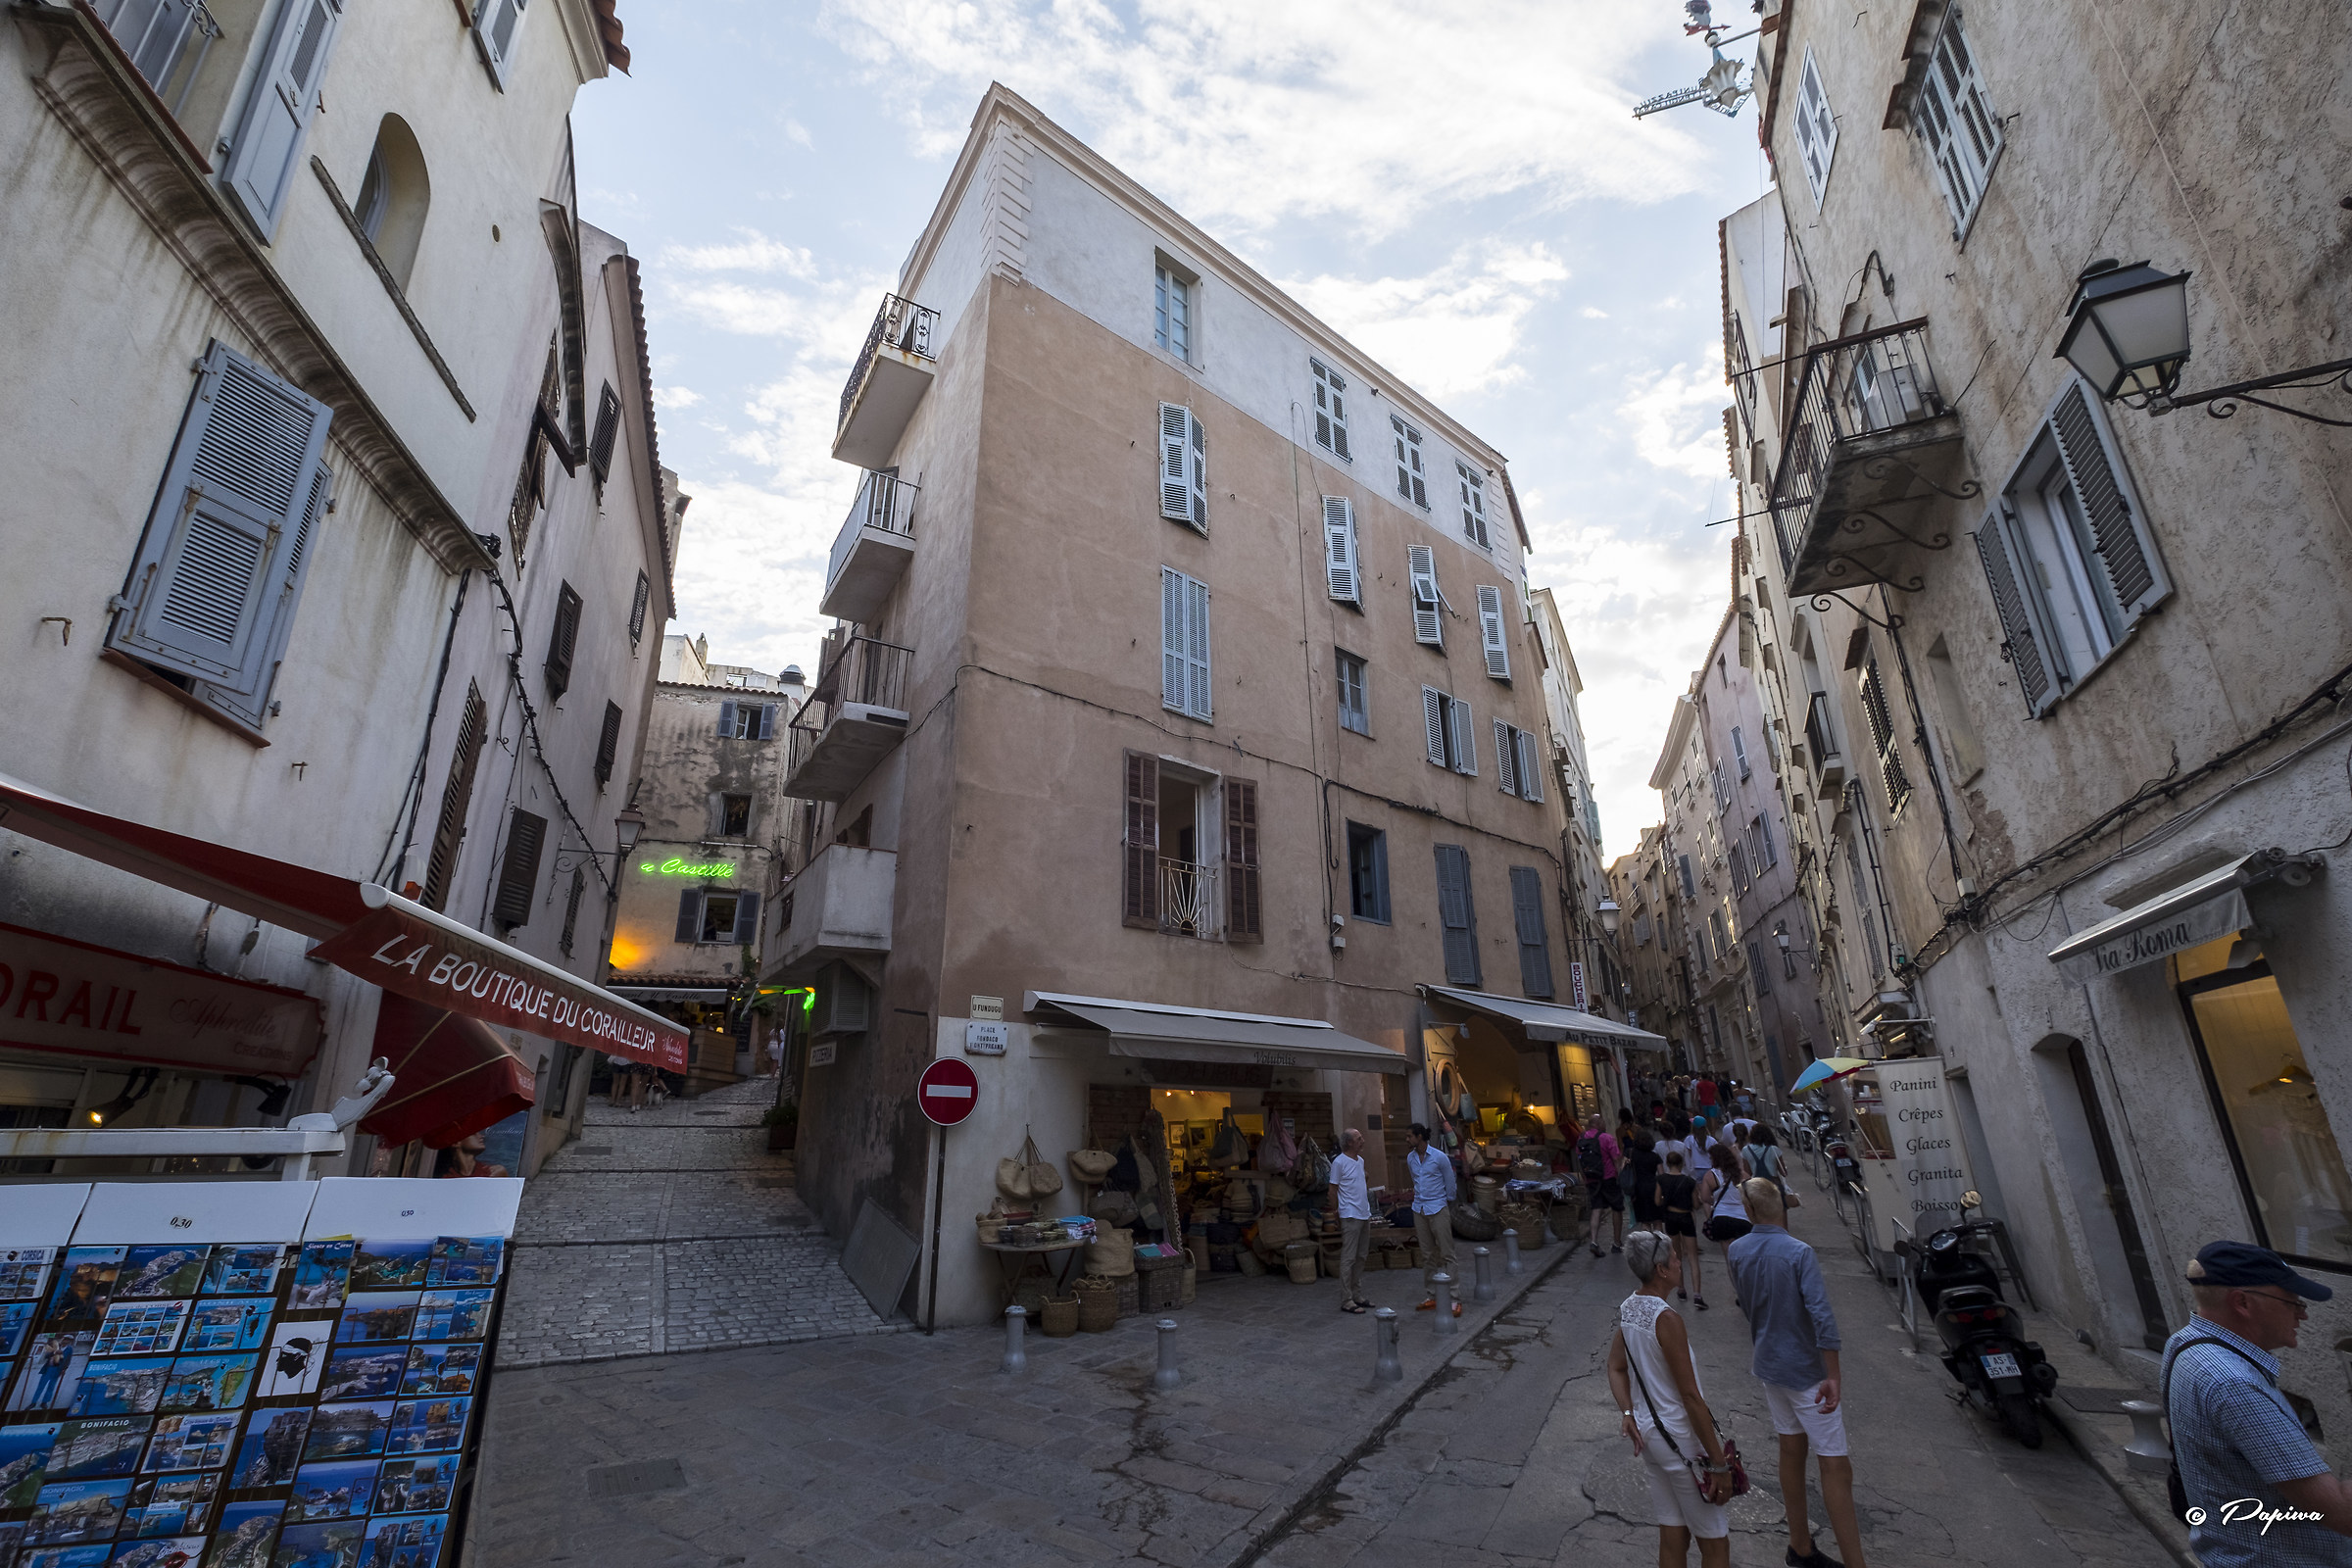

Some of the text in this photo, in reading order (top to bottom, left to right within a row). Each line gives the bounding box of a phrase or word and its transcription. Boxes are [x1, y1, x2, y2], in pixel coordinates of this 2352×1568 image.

[661, 858, 736, 878] Castillé
[2090, 921, 2192, 974] Via Roma
[370, 933, 657, 1053] LA BOUTIQUE DU CORAILLEUR
[169, 994, 276, 1039] Aphrodite
[1253, 1051, 1297, 1066] Volubilis
[1889, 1077, 1937, 1092] Panini
[1898, 1107, 1944, 1124] Crêpes
[1906, 1137, 1951, 1155] Glaces
[1908, 1166, 1964, 1186] Granita
[1911, 1199, 1961, 1213] Boisso
[170, 1216, 193, 1229] 0,30
[80, 1419, 130, 1429] BONIFACIO
